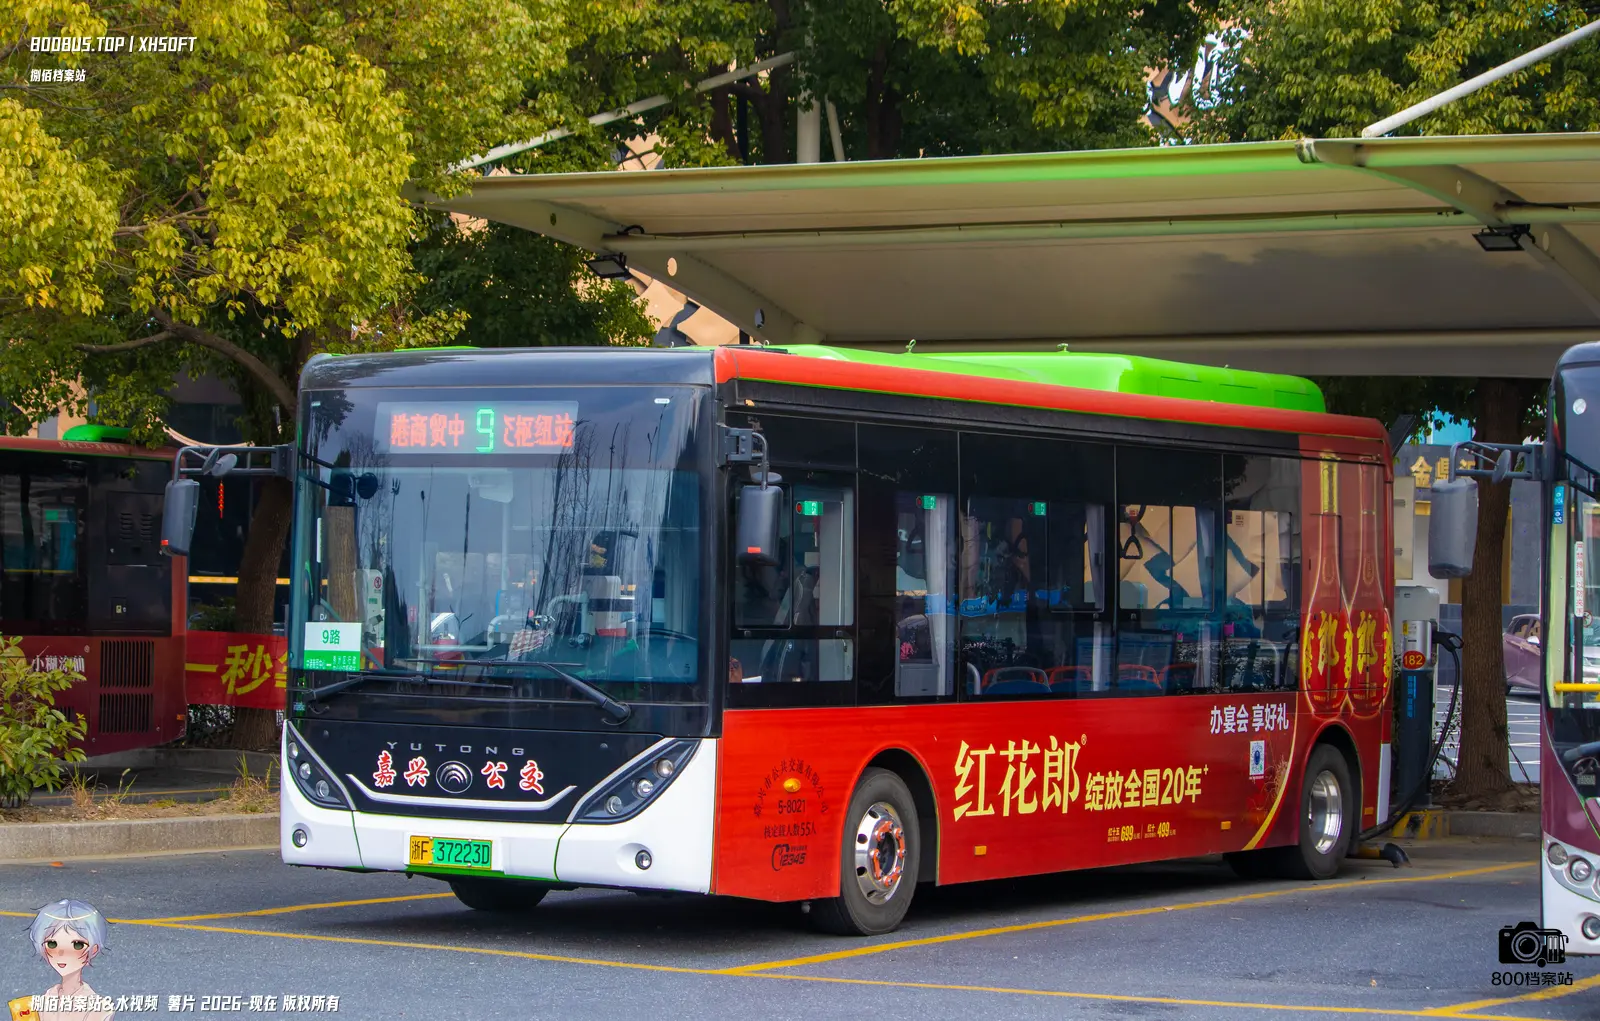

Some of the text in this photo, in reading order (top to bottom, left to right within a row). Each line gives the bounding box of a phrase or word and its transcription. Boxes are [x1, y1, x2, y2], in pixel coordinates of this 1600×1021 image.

[475, 408, 495, 452] 9
[322, 629, 341, 645] 9路
[1404, 655, 1423, 666] 182
[1210, 703, 1289, 734] 办宴会 享好礼
[387, 741, 525, 756] YUTONG
[373, 750, 544, 794] 嘉兴 公交
[778, 799, 806, 814] 5-8021
[1120, 825, 1134, 842] 699
[1157, 821, 1170, 838] 499
[436, 841, 490, 865] 37223D
[780, 853, 806, 867] 12345
